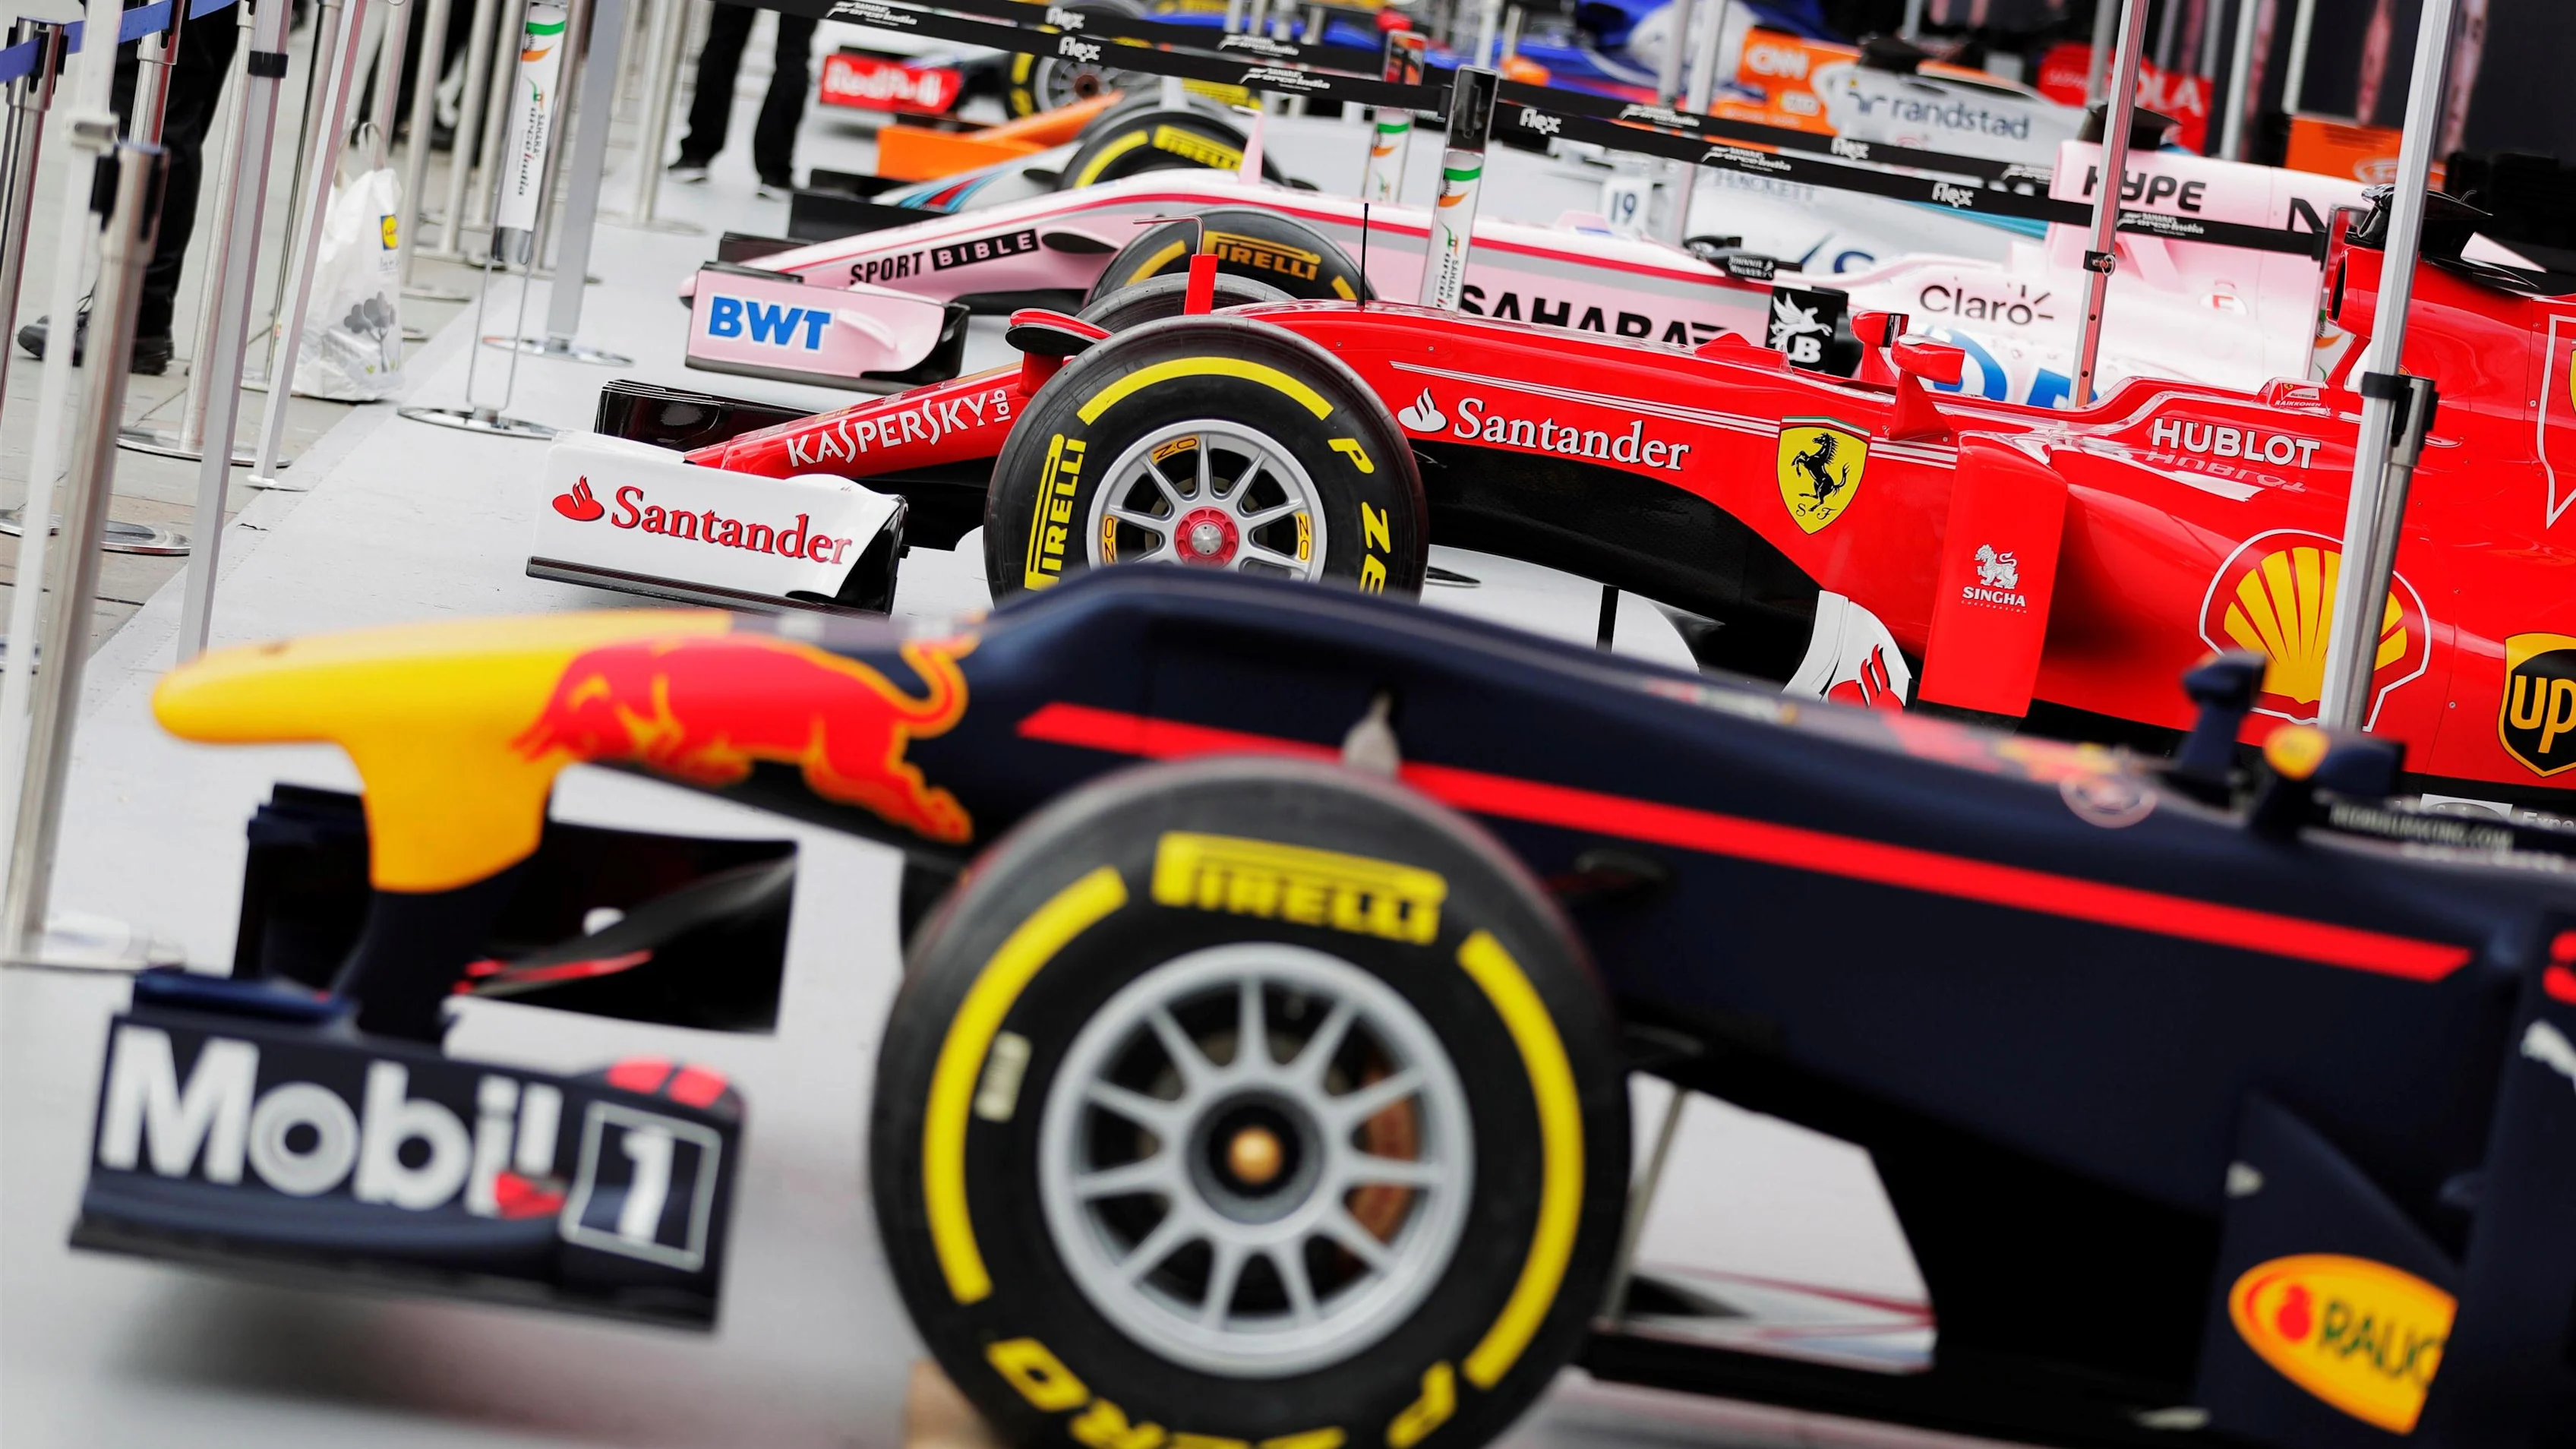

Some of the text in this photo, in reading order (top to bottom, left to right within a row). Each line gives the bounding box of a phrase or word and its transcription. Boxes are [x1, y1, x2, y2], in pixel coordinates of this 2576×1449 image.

[1892, 99, 2031, 140] randstad
[1611, 191, 1638, 223] 19
[849, 232, 1034, 286] SPORT BIBLE
[1201, 230, 1322, 281] PIRELLI
[708, 295, 832, 351] BWT
[1919, 283, 2034, 327] Claro
[785, 388, 1012, 469] KASPERSKY lab
[1453, 396, 1690, 472] Santander
[2151, 416, 2322, 470] HUBLOT
[610, 485, 854, 566] Santander
[1024, 433, 1088, 592] PIRELLI
[1795, 503, 1806, 517] S
[1962, 586, 2026, 608] SINGHA
[1151, 830, 1448, 946] PIRELLI
[98, 1024, 676, 1245] Mobil 1
